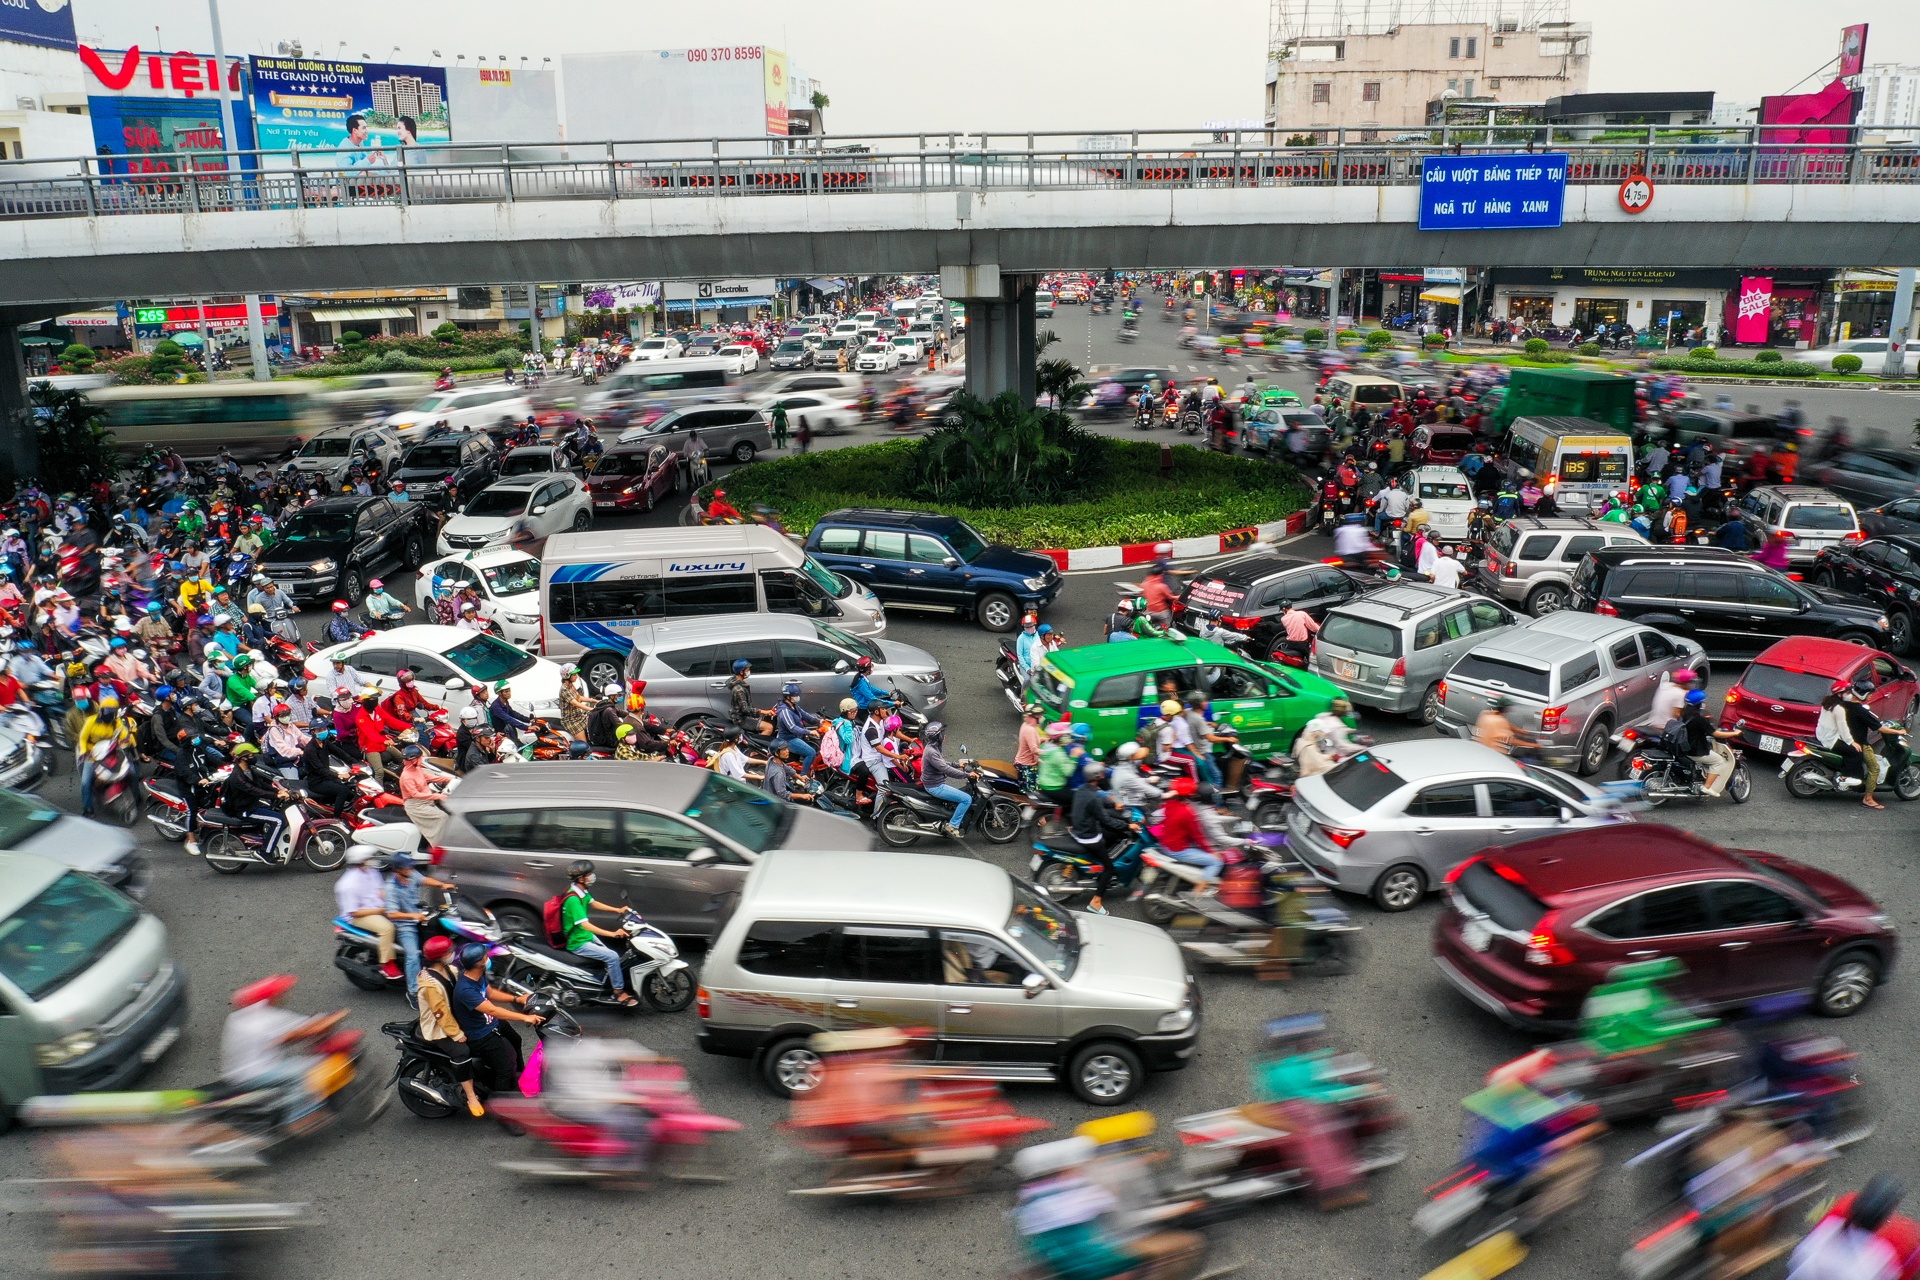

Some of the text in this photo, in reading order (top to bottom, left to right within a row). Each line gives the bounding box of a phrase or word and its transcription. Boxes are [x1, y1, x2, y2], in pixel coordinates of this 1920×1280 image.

[687, 49, 708, 62] 090
[711, 48, 731, 61] 370
[734, 46, 762, 60] 8596
[257, 59, 275, 69] KHU
[328, 64, 334, 72] &
[335, 64, 364, 74] CASINO
[257, 70, 280, 80] THE
[281, 71, 319, 83] GRAND
[337, 74, 366, 85] TRÀM
[1426, 168, 1446, 183] CẦU
[1451, 168, 1479, 185] VƯỢT
[1515, 165, 1542, 181] THÉP
[1547, 168, 1563, 183] TẠI
[1434, 198, 1549, 214] NGÃ TƯ HÀNG XANH
[1583, 269, 1609, 277] TRUNG
[715, 285, 749, 293] Electrolux
[1743, 293, 1762, 305] BIG
[1741, 300, 1769, 314] SALE
[138, 311, 166, 321] 265
[138, 329, 170, 339] 265
[1565, 462, 1586, 473] iBS
[669, 562, 746, 573] luxury
